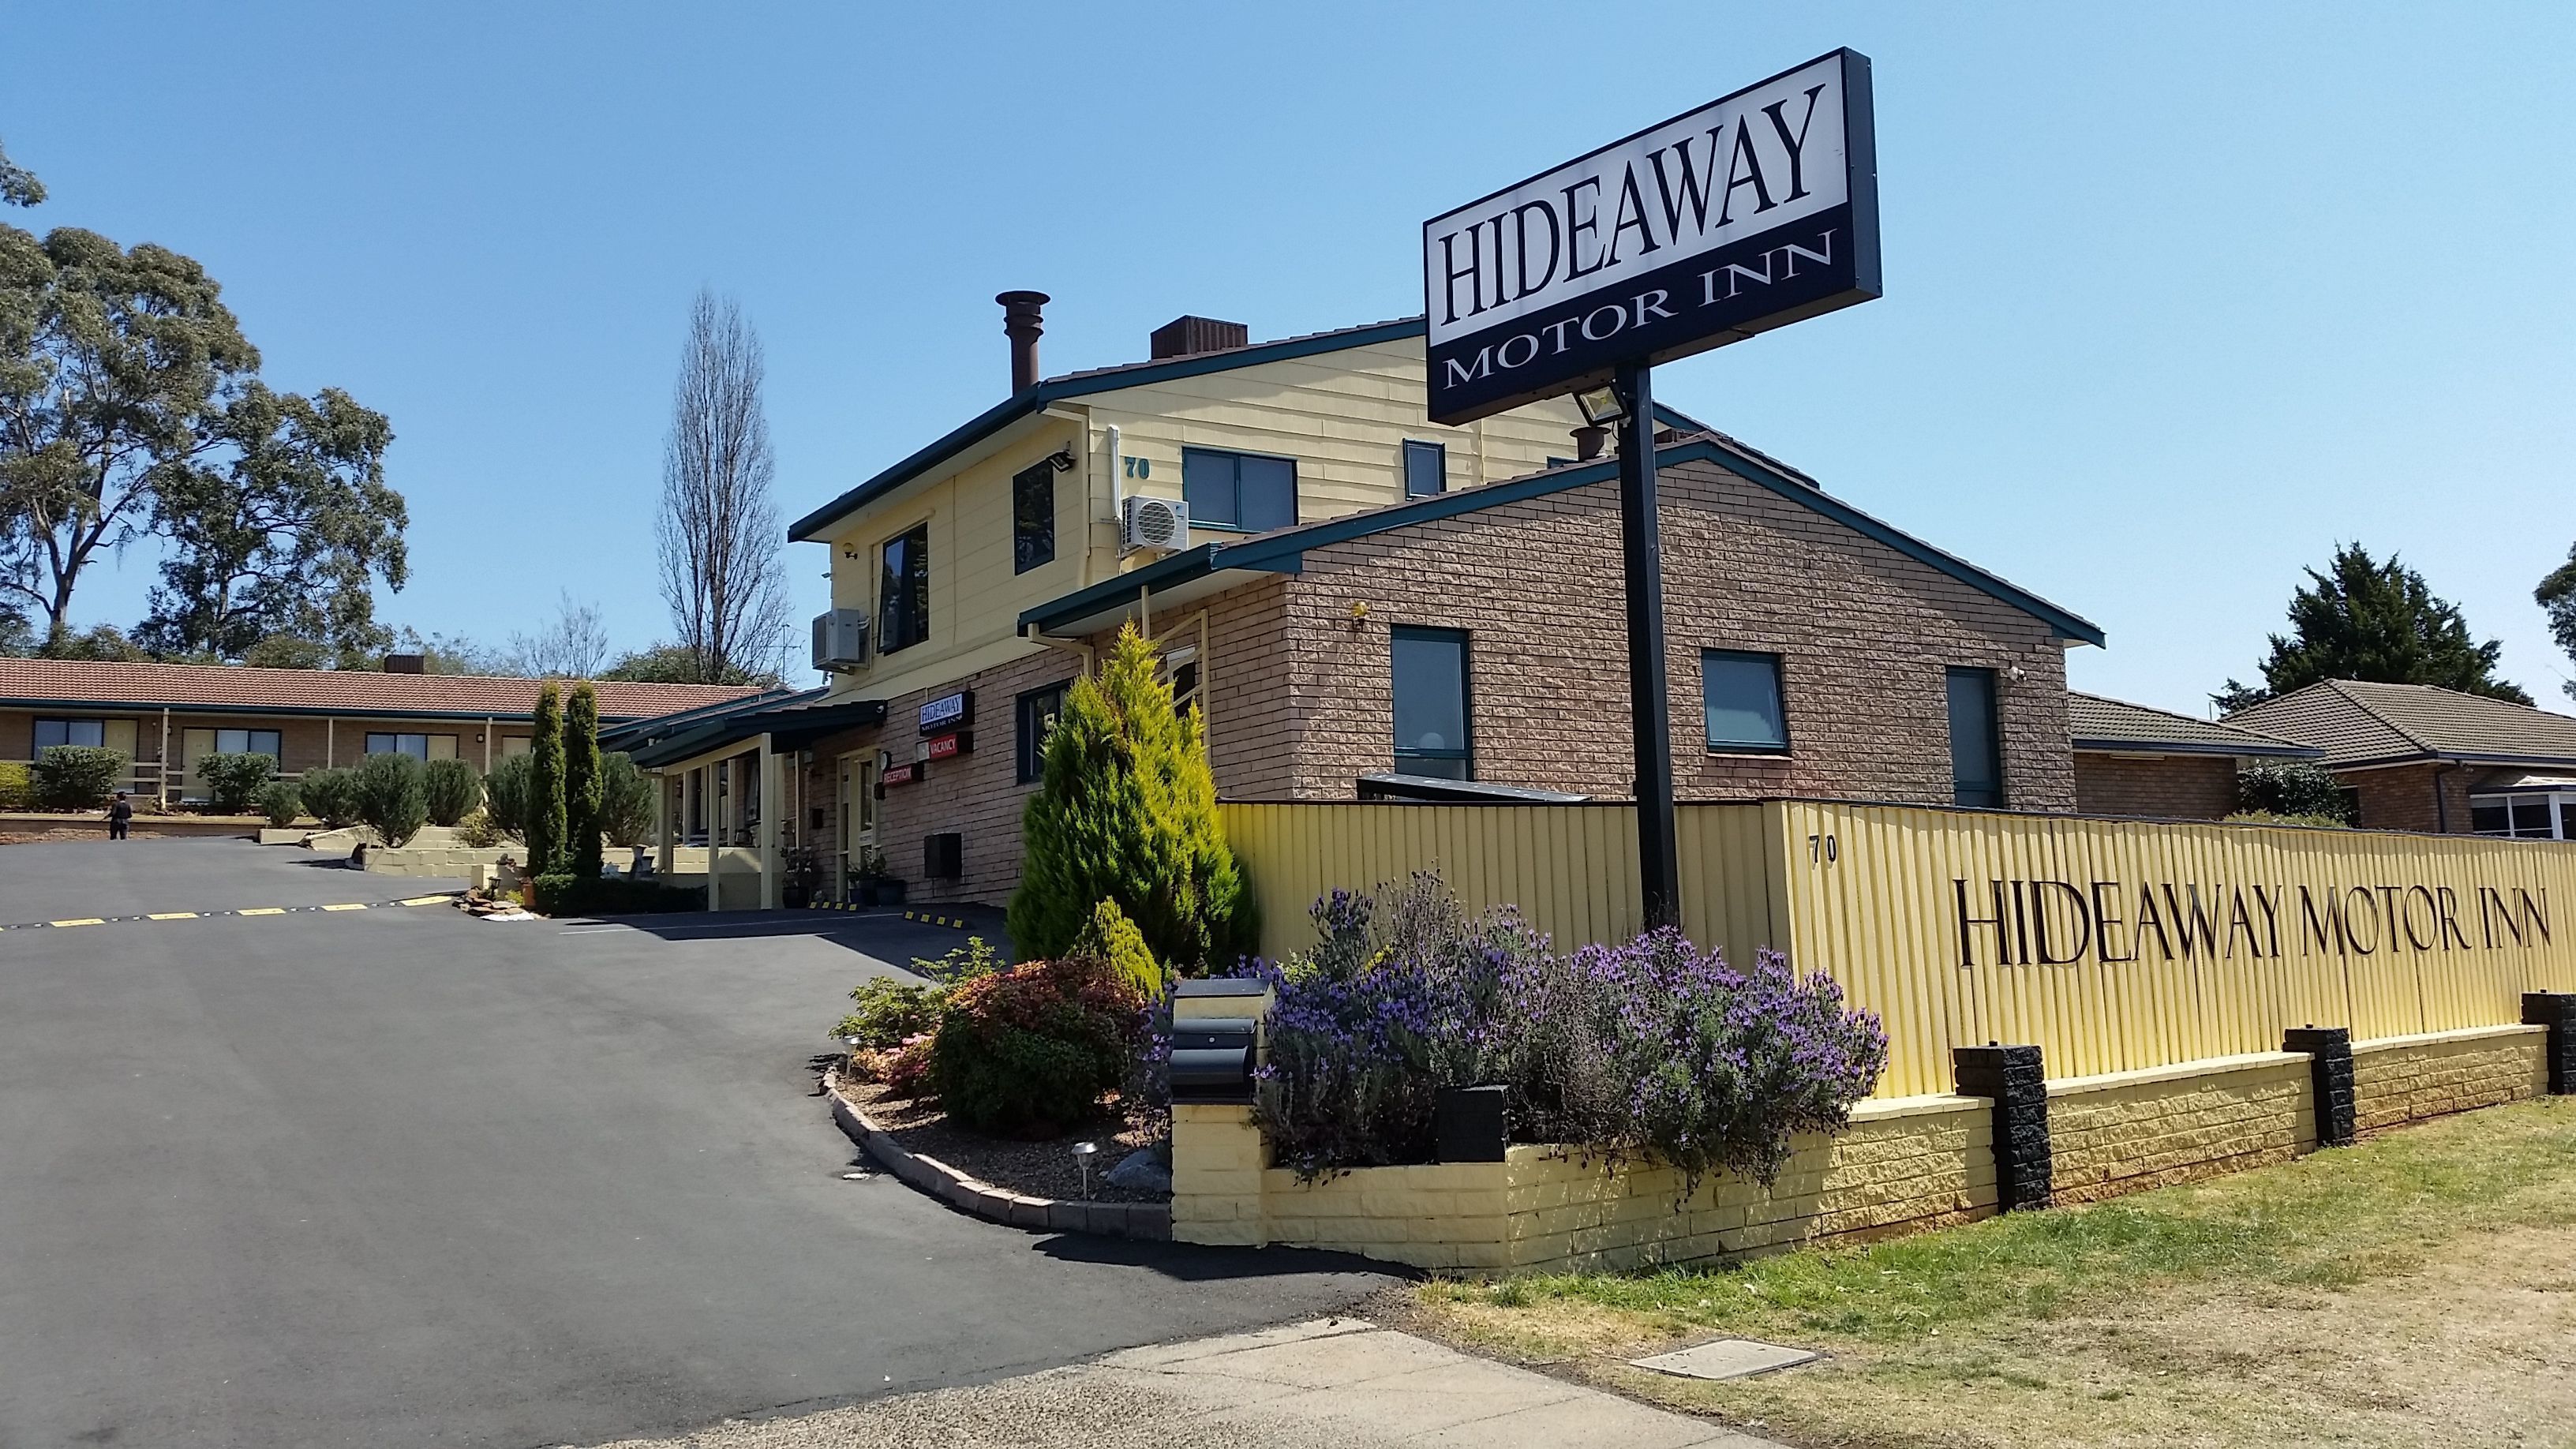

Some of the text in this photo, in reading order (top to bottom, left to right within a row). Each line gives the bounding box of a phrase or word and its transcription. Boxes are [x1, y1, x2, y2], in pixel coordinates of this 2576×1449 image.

[1438, 83, 1825, 327] HIDEAWAY
[1442, 228, 1838, 390] MOTOR INN
[1124, 456, 1150, 480] 70
[921, 696, 961, 722] HIDEAWAY
[921, 714, 962, 731] MOTOR INN
[930, 738, 957, 754] VACANCY
[884, 767, 912, 783] RECEPTION
[1808, 834, 1837, 863] 70
[1953, 878, 2552, 967] HIDEAWAY MOTOR INN
